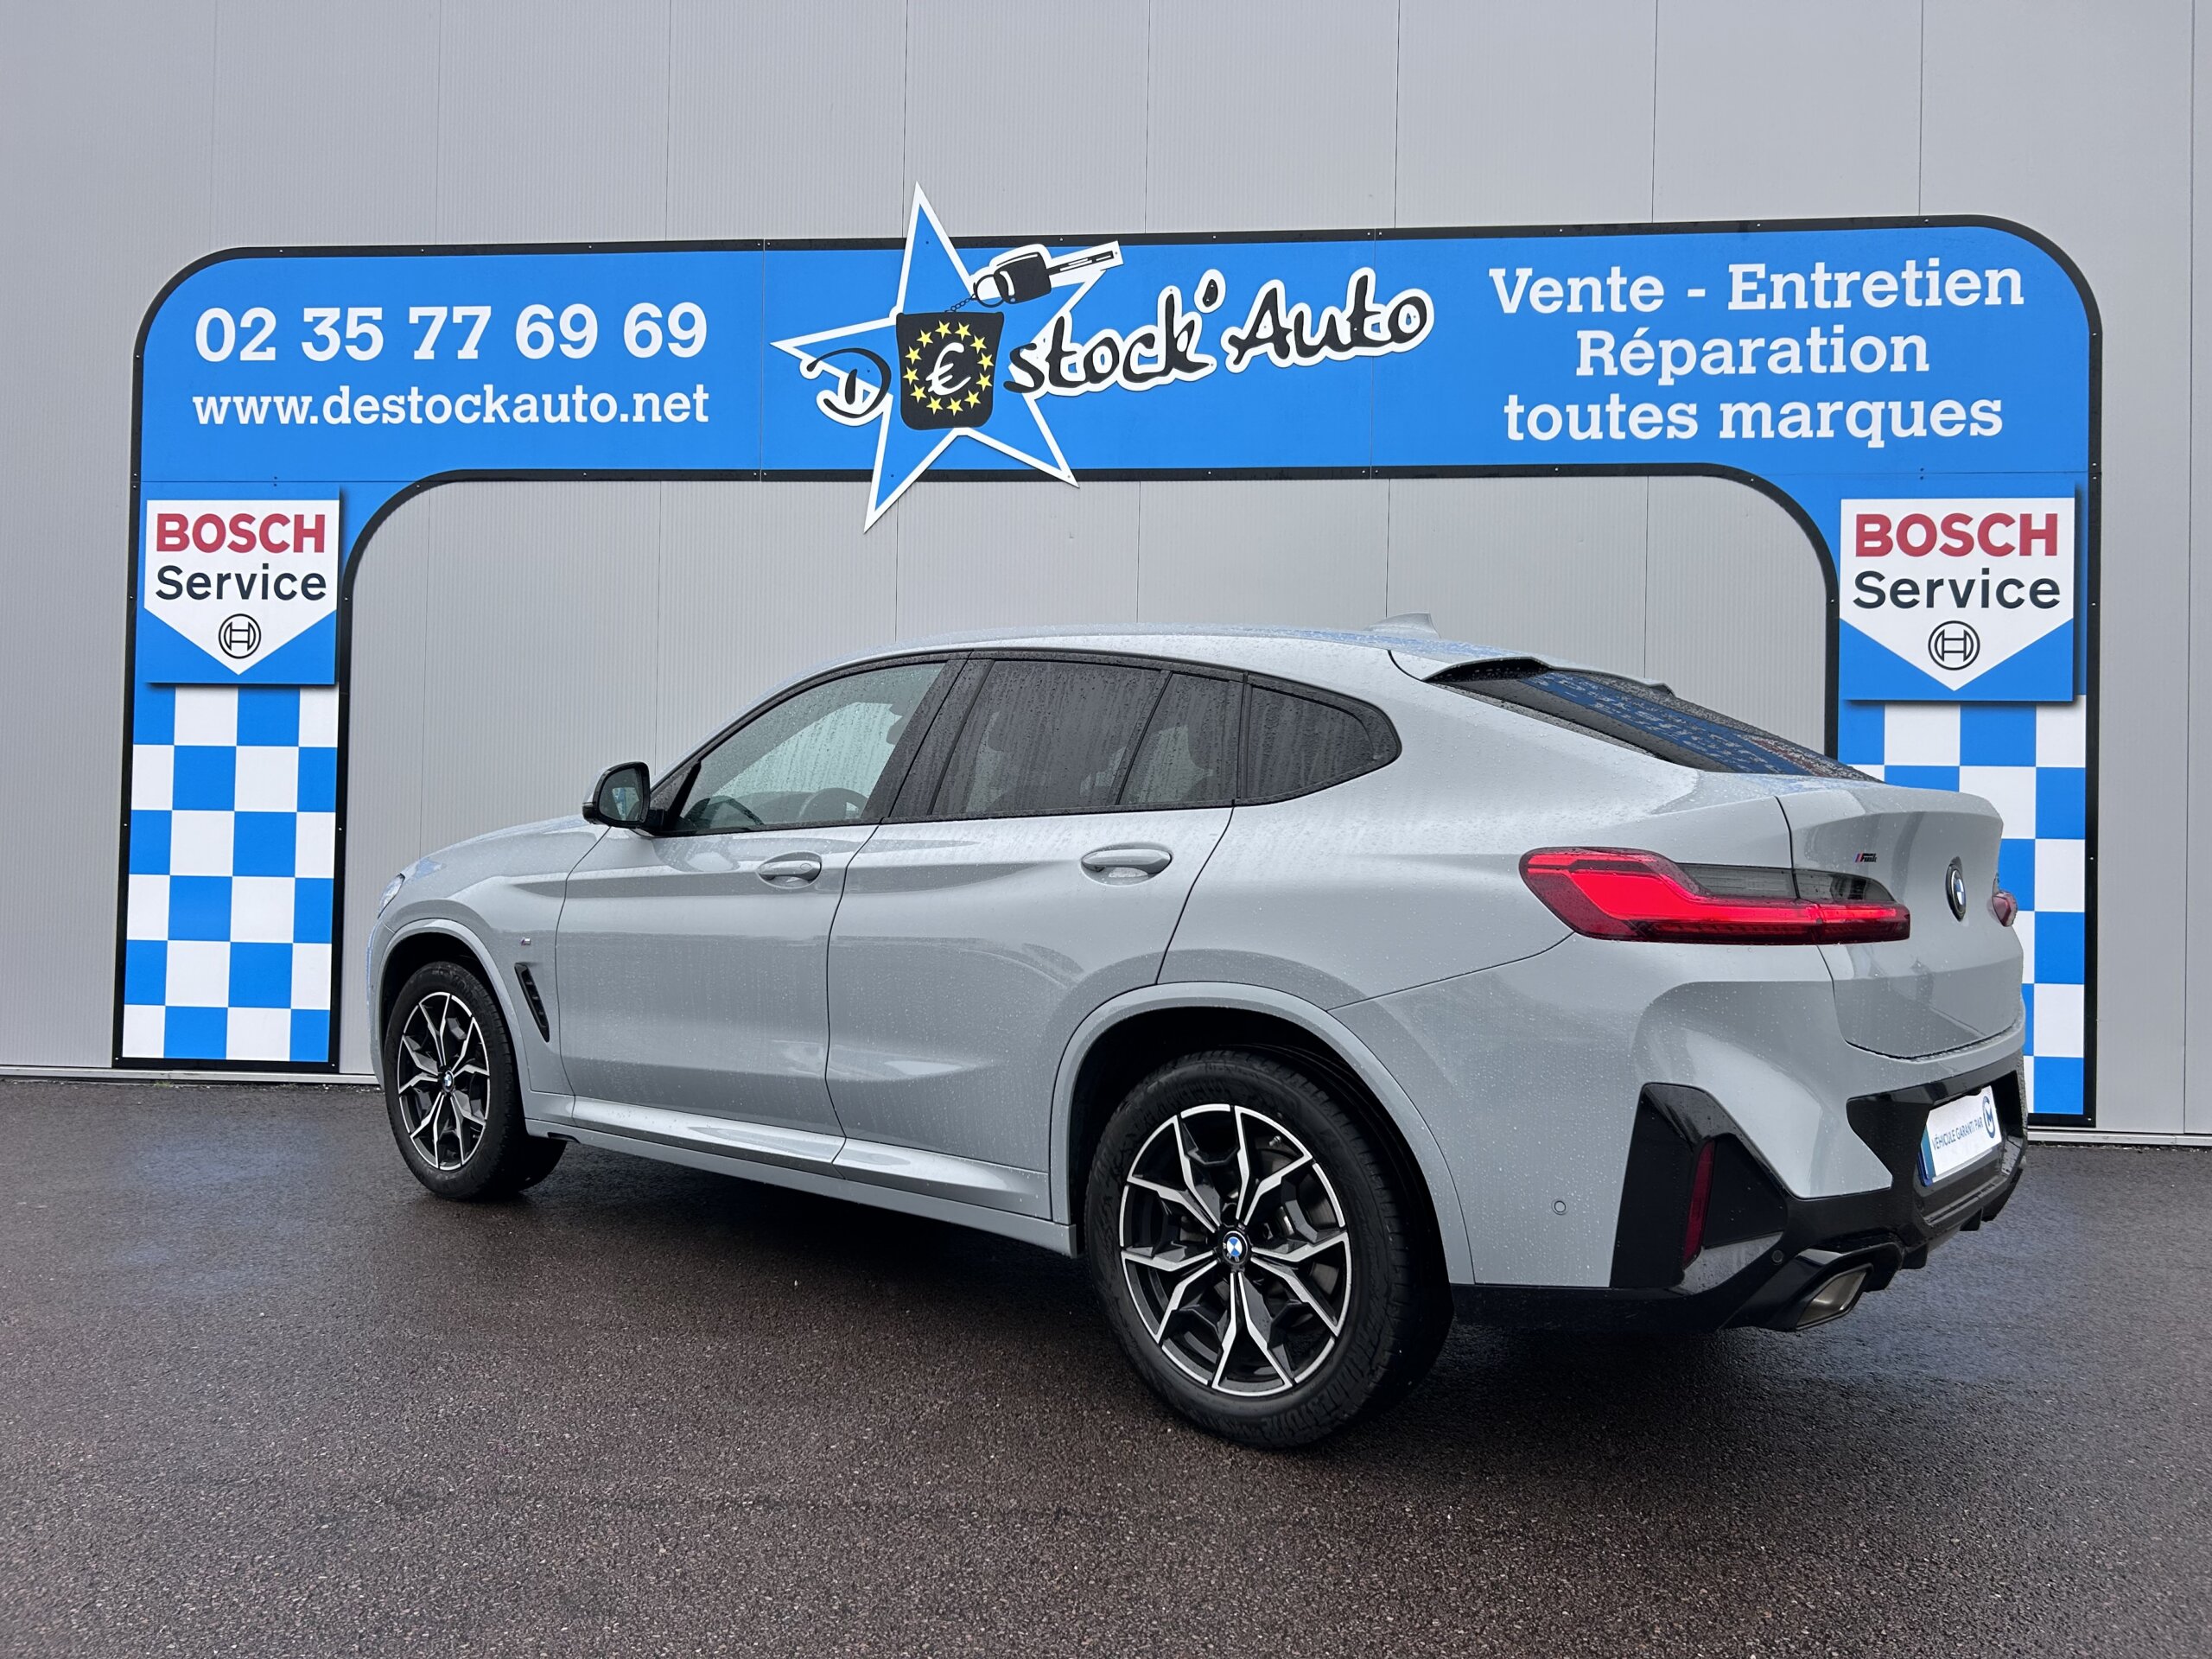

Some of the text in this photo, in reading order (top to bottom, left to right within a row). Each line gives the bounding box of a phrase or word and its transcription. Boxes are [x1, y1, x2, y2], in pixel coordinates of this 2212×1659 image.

[1489, 257, 2024, 314] Vente - Entretien
[196, 302, 707, 362] 02 35 77 69 69
[1576, 324, 1929, 386] Réparation
[192, 384, 709, 425] www.destockauto.net
[1503, 393, 2003, 448] toutes marques
[156, 513, 325, 554] BOSCH
[1856, 512, 2058, 557] BOSCH
[156, 563, 327, 601] Service
[1853, 567, 2060, 609] Service
